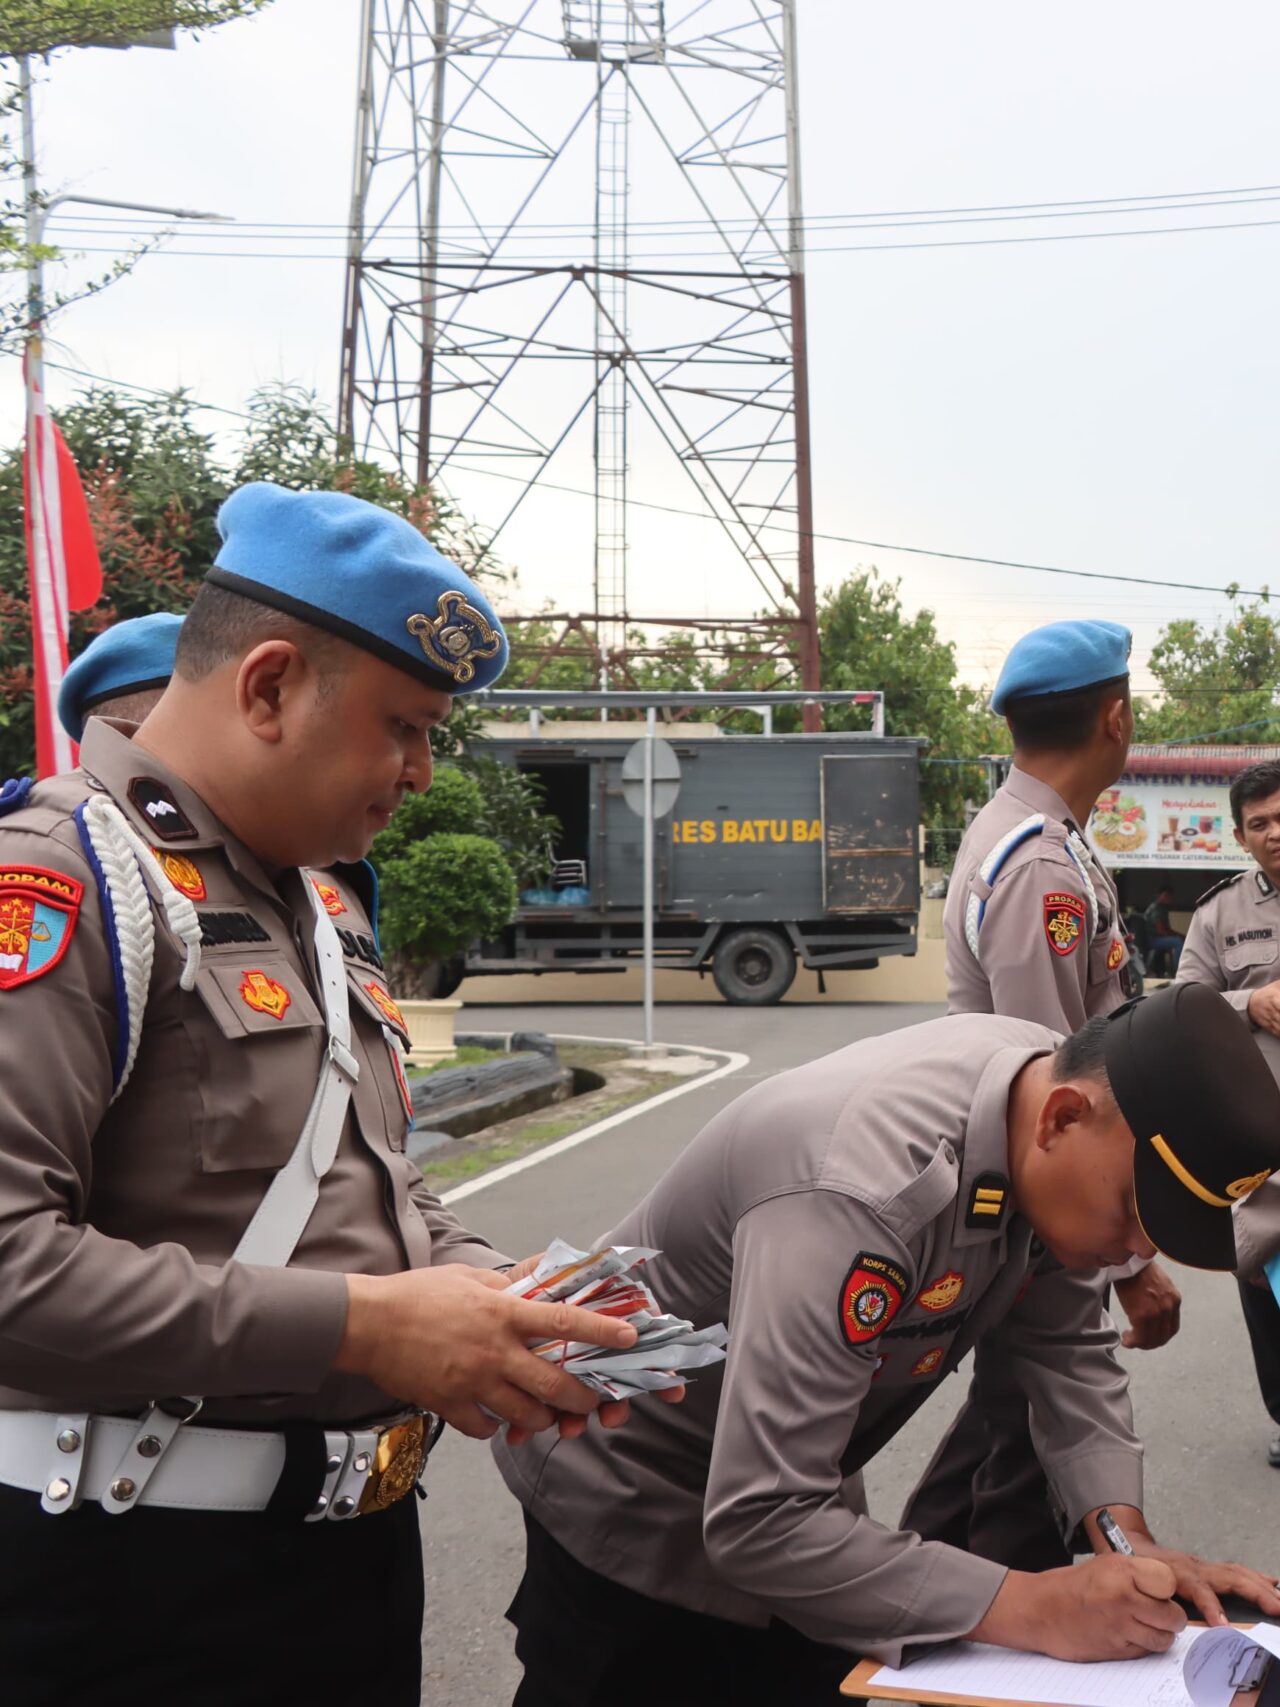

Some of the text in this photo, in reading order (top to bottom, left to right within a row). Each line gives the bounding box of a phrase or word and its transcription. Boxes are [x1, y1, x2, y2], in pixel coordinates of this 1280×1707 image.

[722, 820, 788, 843] BATU
[0, 873, 70, 895] OPAM
[863, 1257, 887, 1271] KORPS
